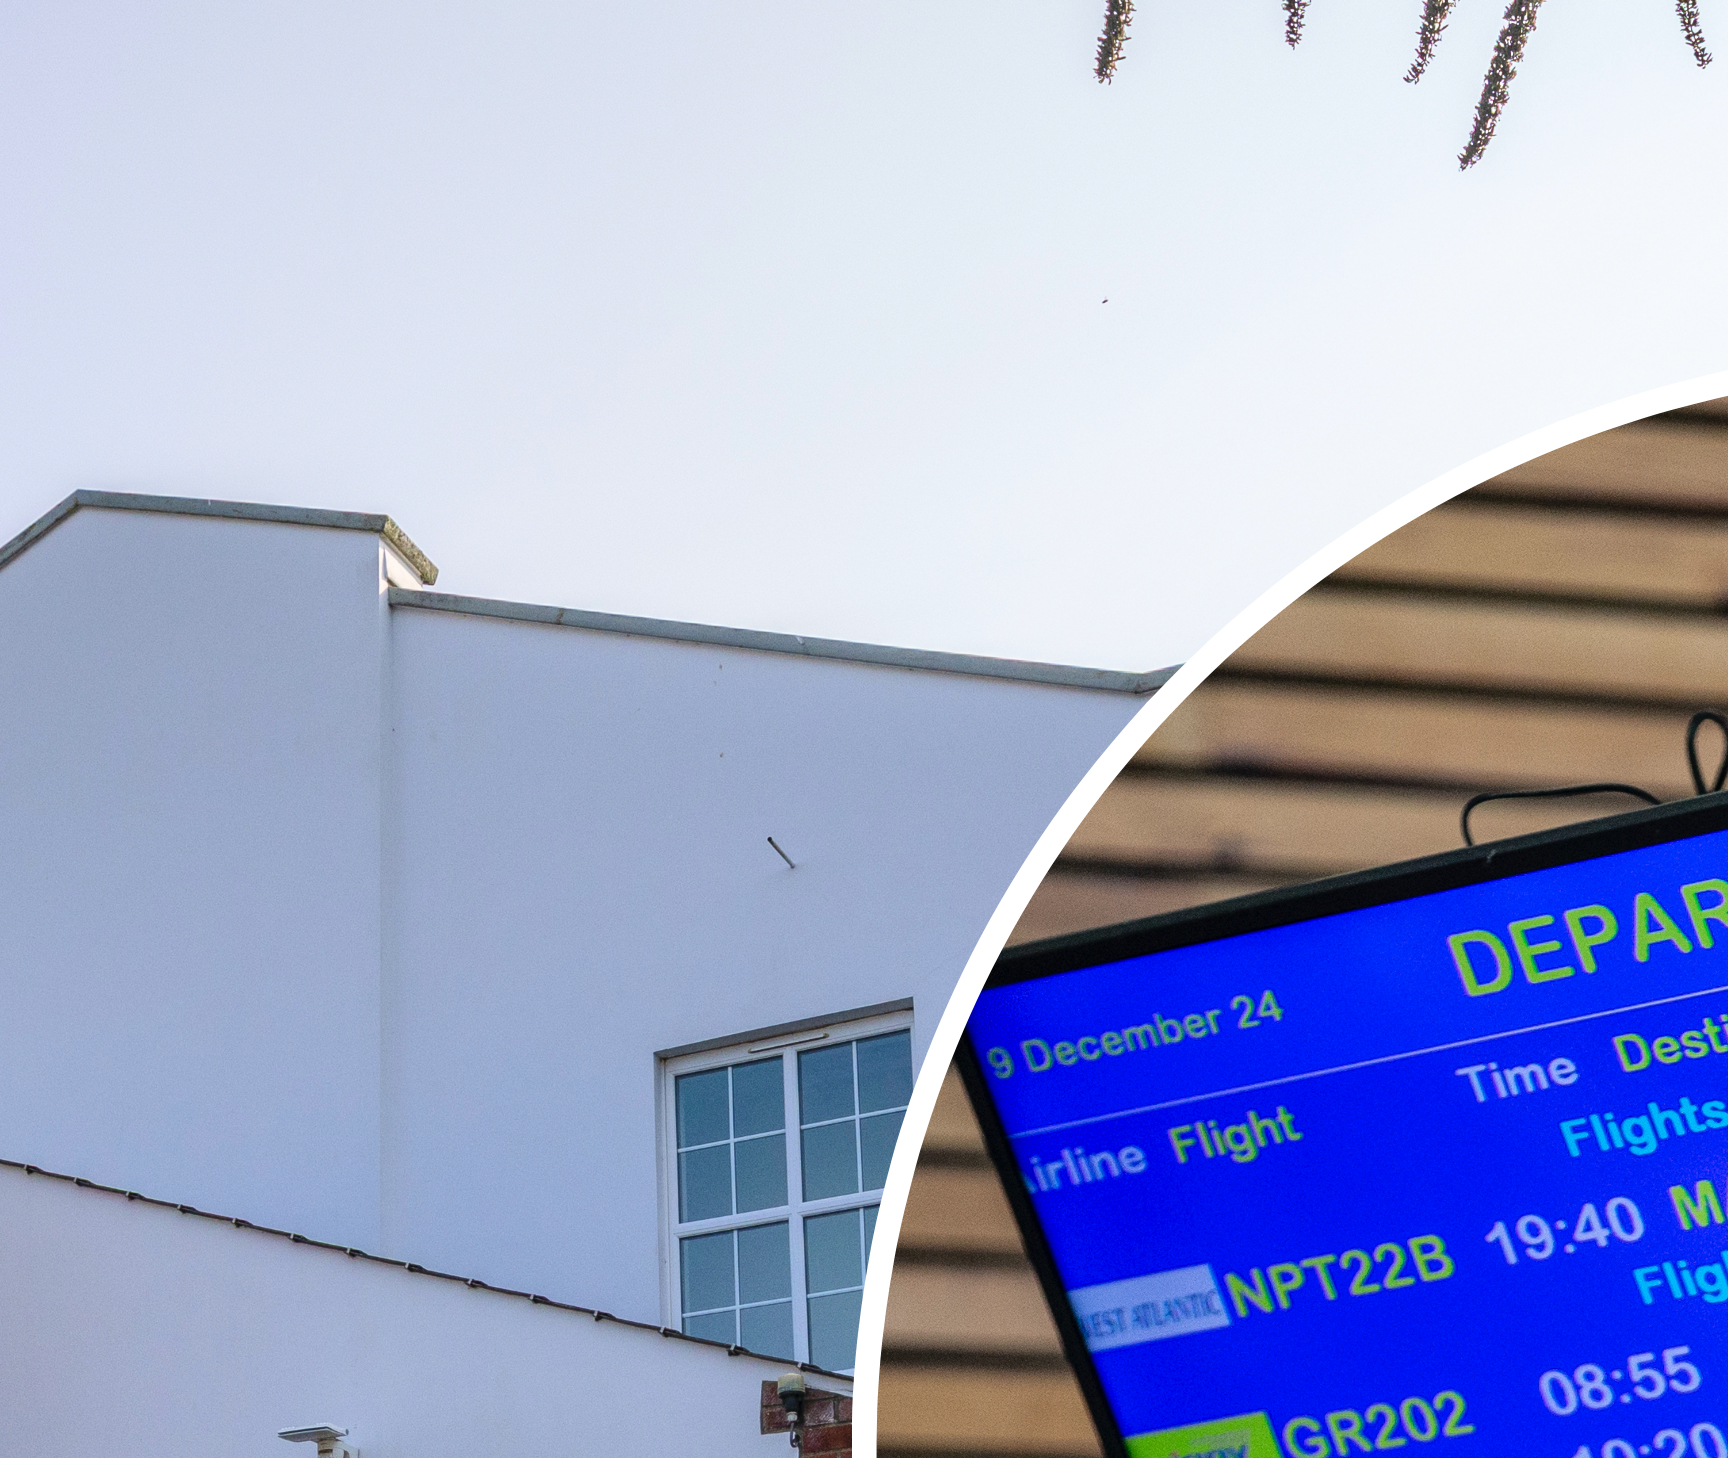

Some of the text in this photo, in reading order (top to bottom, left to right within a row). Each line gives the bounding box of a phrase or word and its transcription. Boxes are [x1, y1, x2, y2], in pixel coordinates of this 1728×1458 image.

[1020, 1009, 1222, 1073] December
[1229, 989, 1284, 1029] 24
[1167, 1105, 1304, 1163] Flight
[1456, 1053, 1579, 1105] Time
[1223, 1234, 1456, 1317] NPT22B
[1485, 1196, 1646, 1266] 19:40
[1539, 1345, 1702, 1416] 08:55
